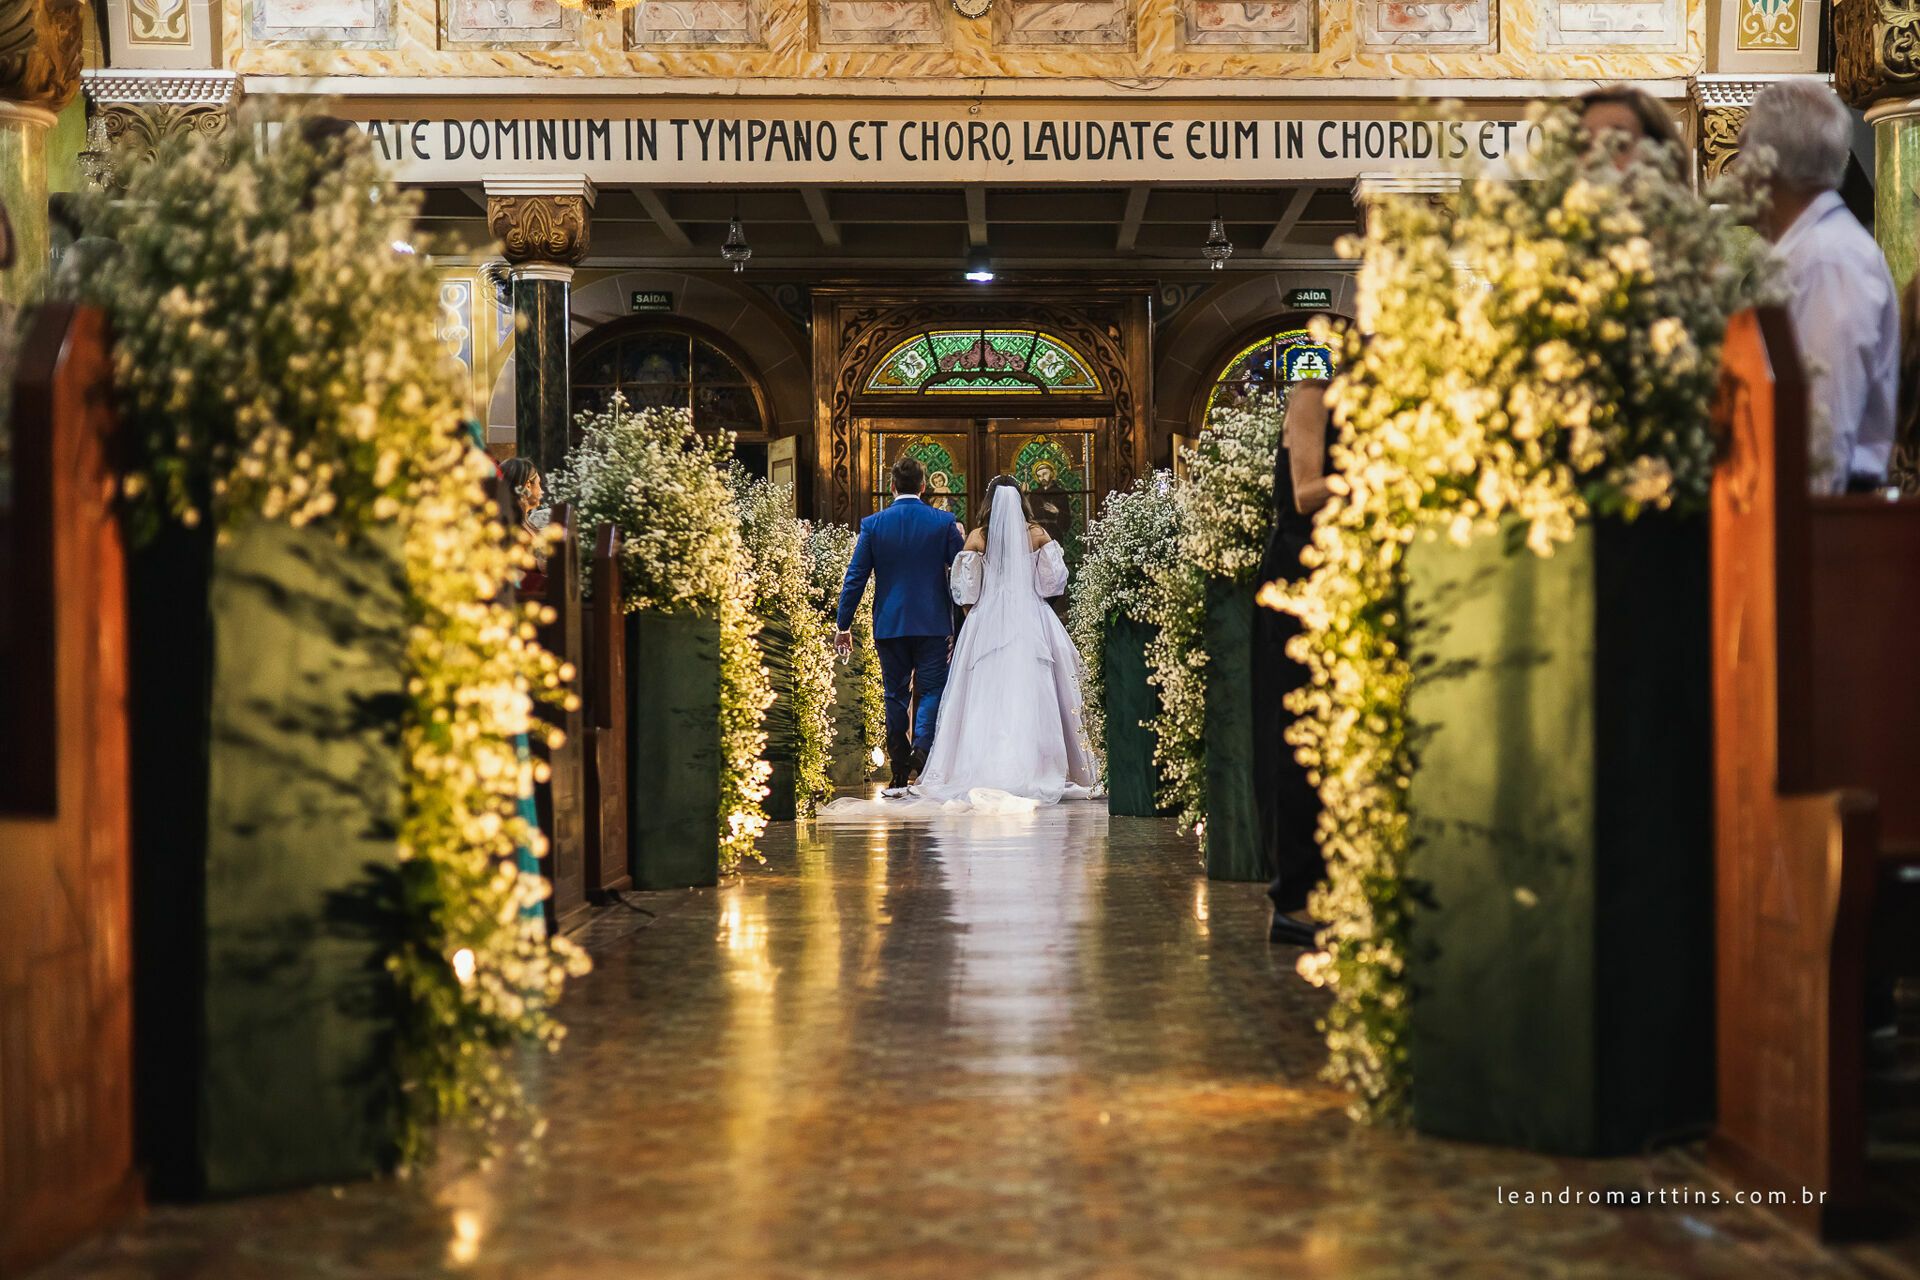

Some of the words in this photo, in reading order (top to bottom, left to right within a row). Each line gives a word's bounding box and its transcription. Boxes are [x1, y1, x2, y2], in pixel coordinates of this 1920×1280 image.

[443, 118, 611, 160] DOMINUM
[625, 118, 657, 161] IN
[669, 118, 837, 162] TYMPANO
[849, 120, 888, 162] ET
[899, 121, 1014, 166] CHORO,
[1023, 121, 1174, 161] LAUDATE
[1186, 121, 1258, 160] EUM
[1274, 121, 1303, 159] IN
[1317, 121, 1468, 159] CHORDIS
[1479, 121, 1517, 159] ET
[636, 293, 667, 303] SAÍDA
[1296, 290, 1327, 300] SAÍDA
